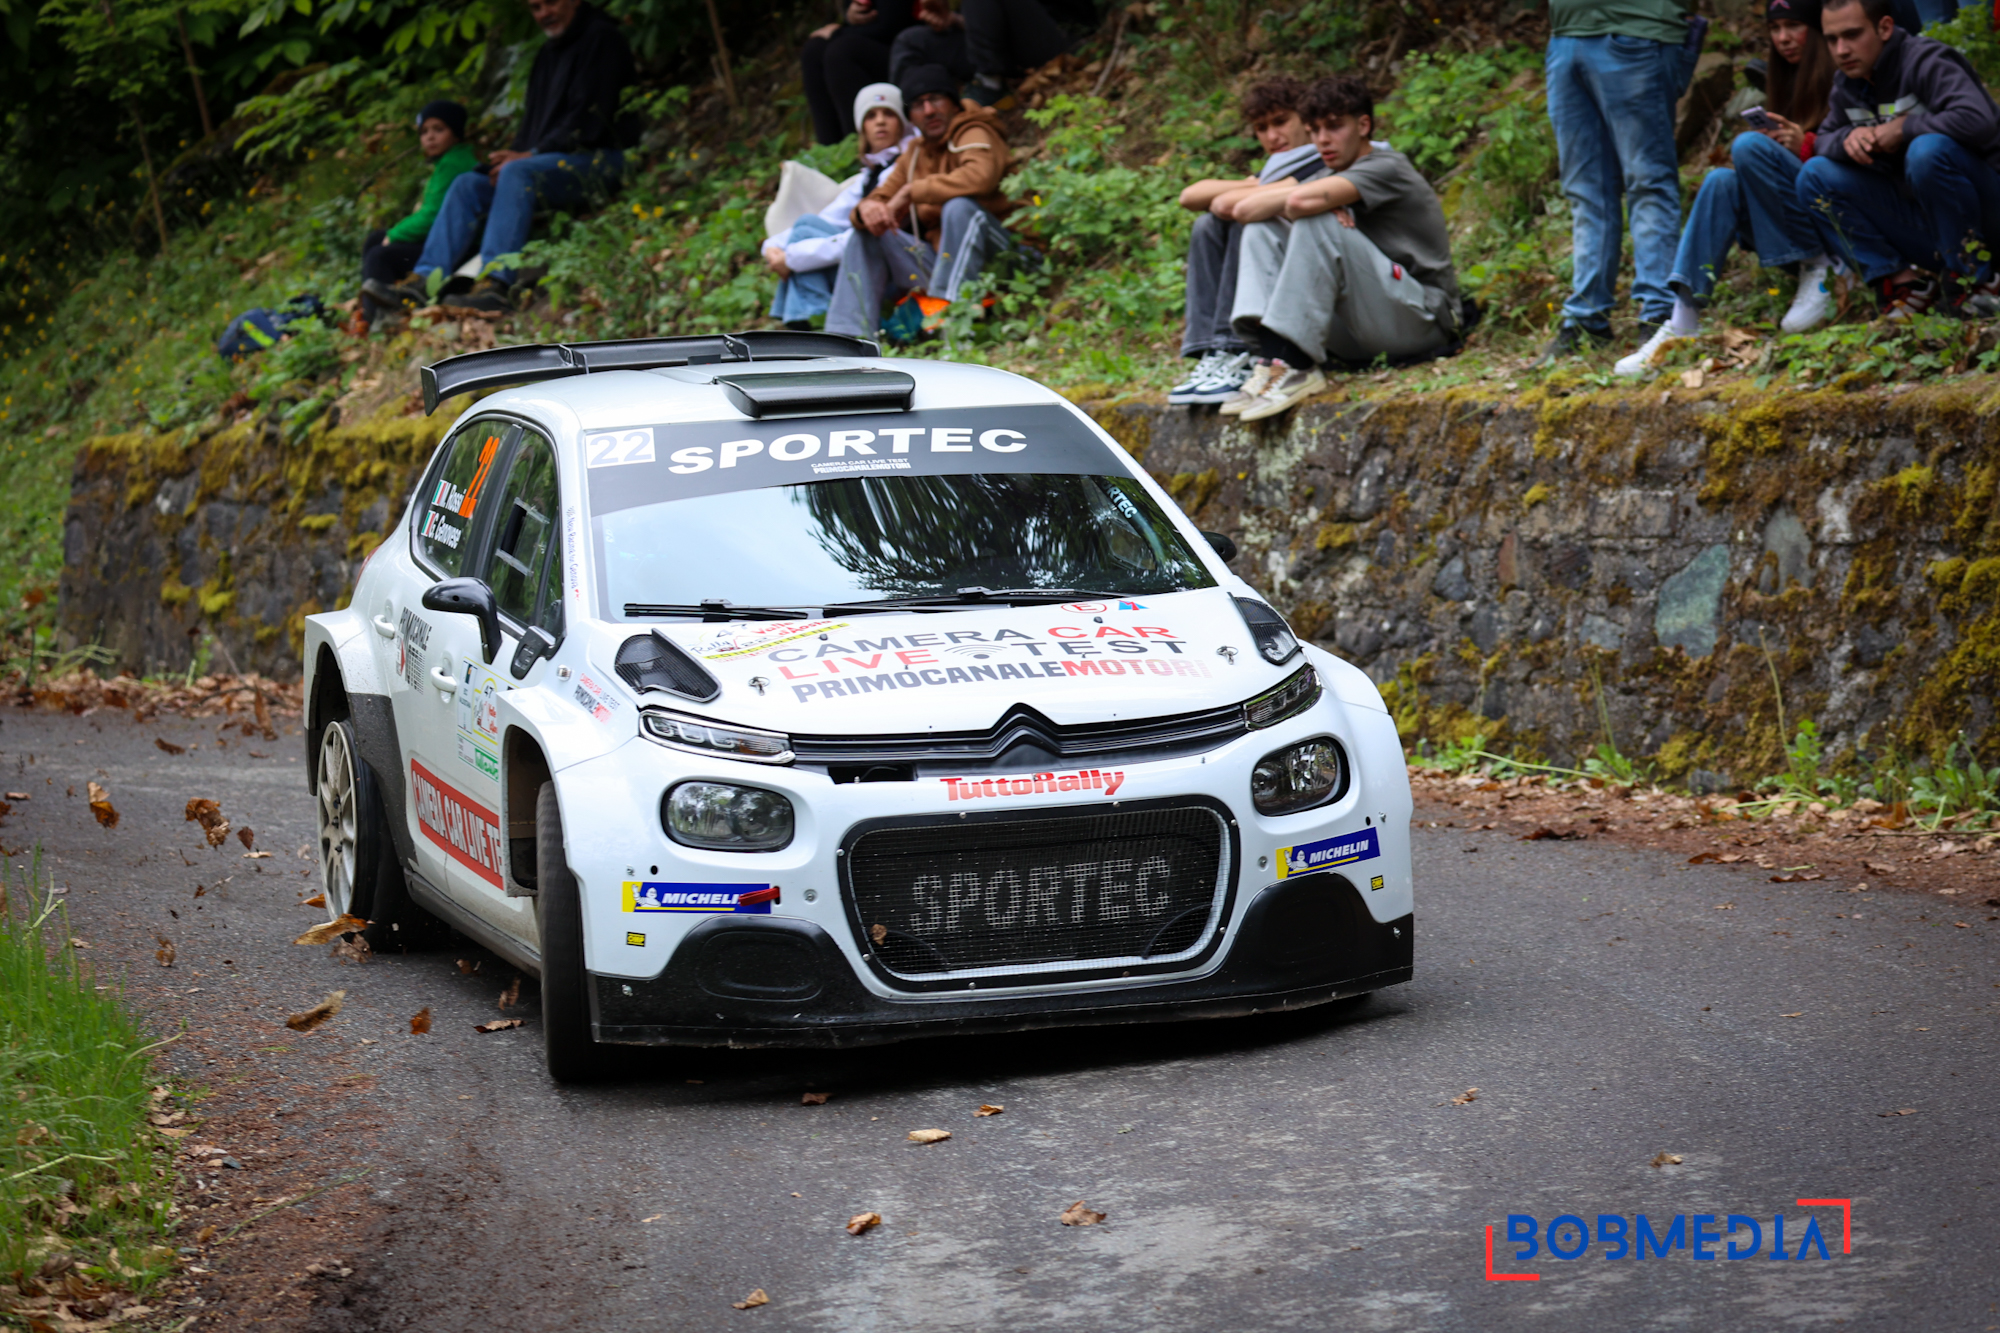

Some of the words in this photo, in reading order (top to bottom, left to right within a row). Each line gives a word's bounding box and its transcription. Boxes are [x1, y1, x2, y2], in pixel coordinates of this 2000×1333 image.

[588, 431, 653, 466] 22
[668, 427, 1028, 474] SPORTEC
[458, 435, 500, 518] 22
[813, 462, 912, 475] PRIMOCANALEMOTORI
[1104, 484, 1138, 519] RTEC
[750, 621, 794, 635] Valle
[768, 628, 1036, 662] CAMERA
[1047, 626, 1179, 639] CAR
[777, 649, 939, 680] LIVE
[1010, 640, 1187, 656] TEST
[791, 658, 1212, 703] PRIMOCANALEMOTORI
[940, 769, 1125, 801] TuttoRally
[412, 769, 449, 841] CAMERA
[444, 794, 468, 855] CAR
[463, 806, 491, 870] LIVE
[1308, 839, 1370, 864] MICHELIN
[662, 893, 741, 905] MICHELI
[909, 855, 1171, 936] SPORTEC
